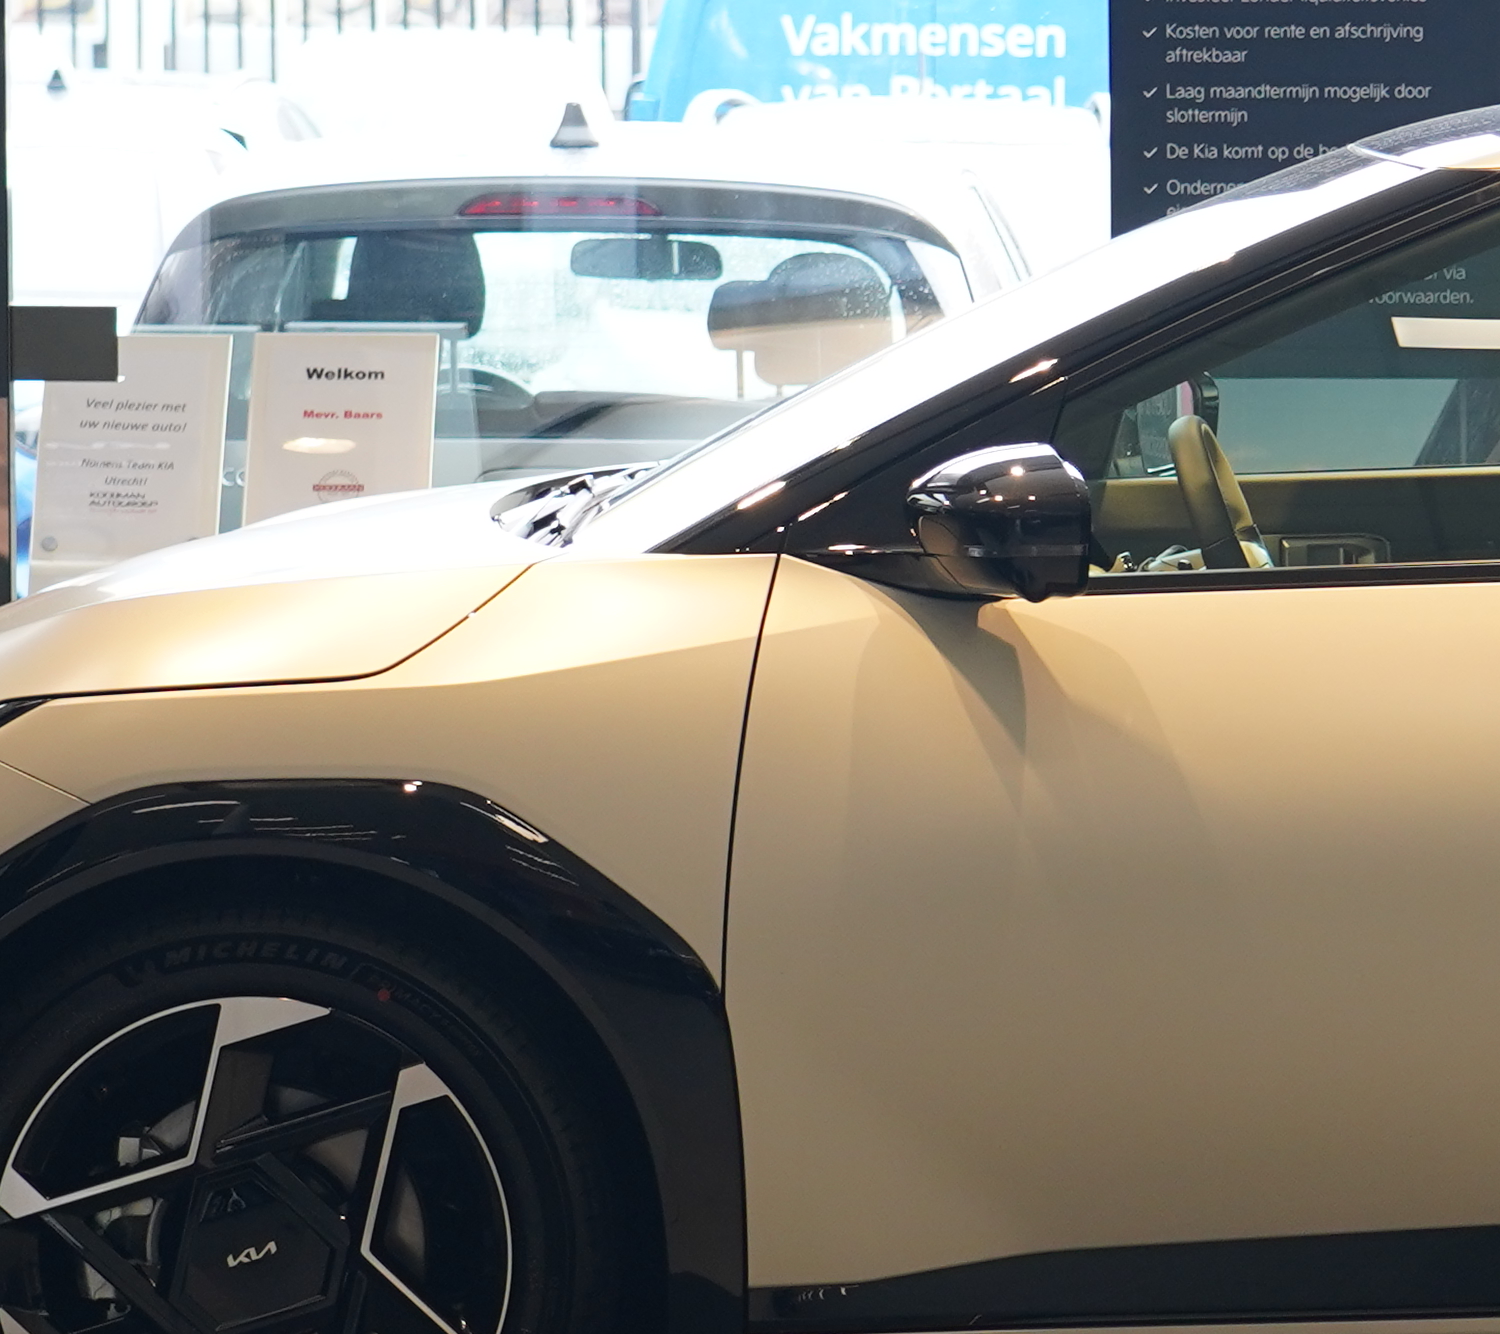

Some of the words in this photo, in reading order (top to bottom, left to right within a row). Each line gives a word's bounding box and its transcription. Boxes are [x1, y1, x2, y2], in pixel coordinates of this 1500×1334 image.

[780, 12, 1066, 58] Vakmensen
[1166, 23, 1219, 39] Kosten
[1224, 27, 1260, 38] voor
[1265, 25, 1305, 38] rente
[1310, 26, 1330, 38] en
[1335, 22, 1423, 42] afschrijving
[1166, 47, 1248, 62] aftrekbaar
[1167, 84, 1204, 102] Laag
[1210, 84, 1319, 102] maandtermijn
[1325, 83, 1390, 102] mogelijk
[1394, 83, 1432, 98] door
[1166, 108, 1247, 126] slottermijn
[1166, 143, 1188, 159] De
[1194, 143, 1217, 159] Kia
[1223, 143, 1263, 159] komt
[1268, 147, 1289, 162] op
[1293, 143, 1313, 159] de
[1166, 180, 1248, 195] Ondern
[1443, 266, 1466, 279] via
[306, 367, 385, 381] Welkom
[86, 398, 114, 408] Veel
[115, 399, 158, 412] plezier
[160, 403, 187, 412] met
[303, 409, 339, 419] Mevr.
[344, 410, 383, 420] Baars
[80, 419, 99, 429] uw
[102, 420, 149, 430] nieuwe
[152, 422, 187, 433] auto!
[127, 461, 155, 469] Team
[158, 462, 174, 470] KIA
[162, 937, 350, 971] MICHELIN
[228, 1240, 277, 1269] KIA
